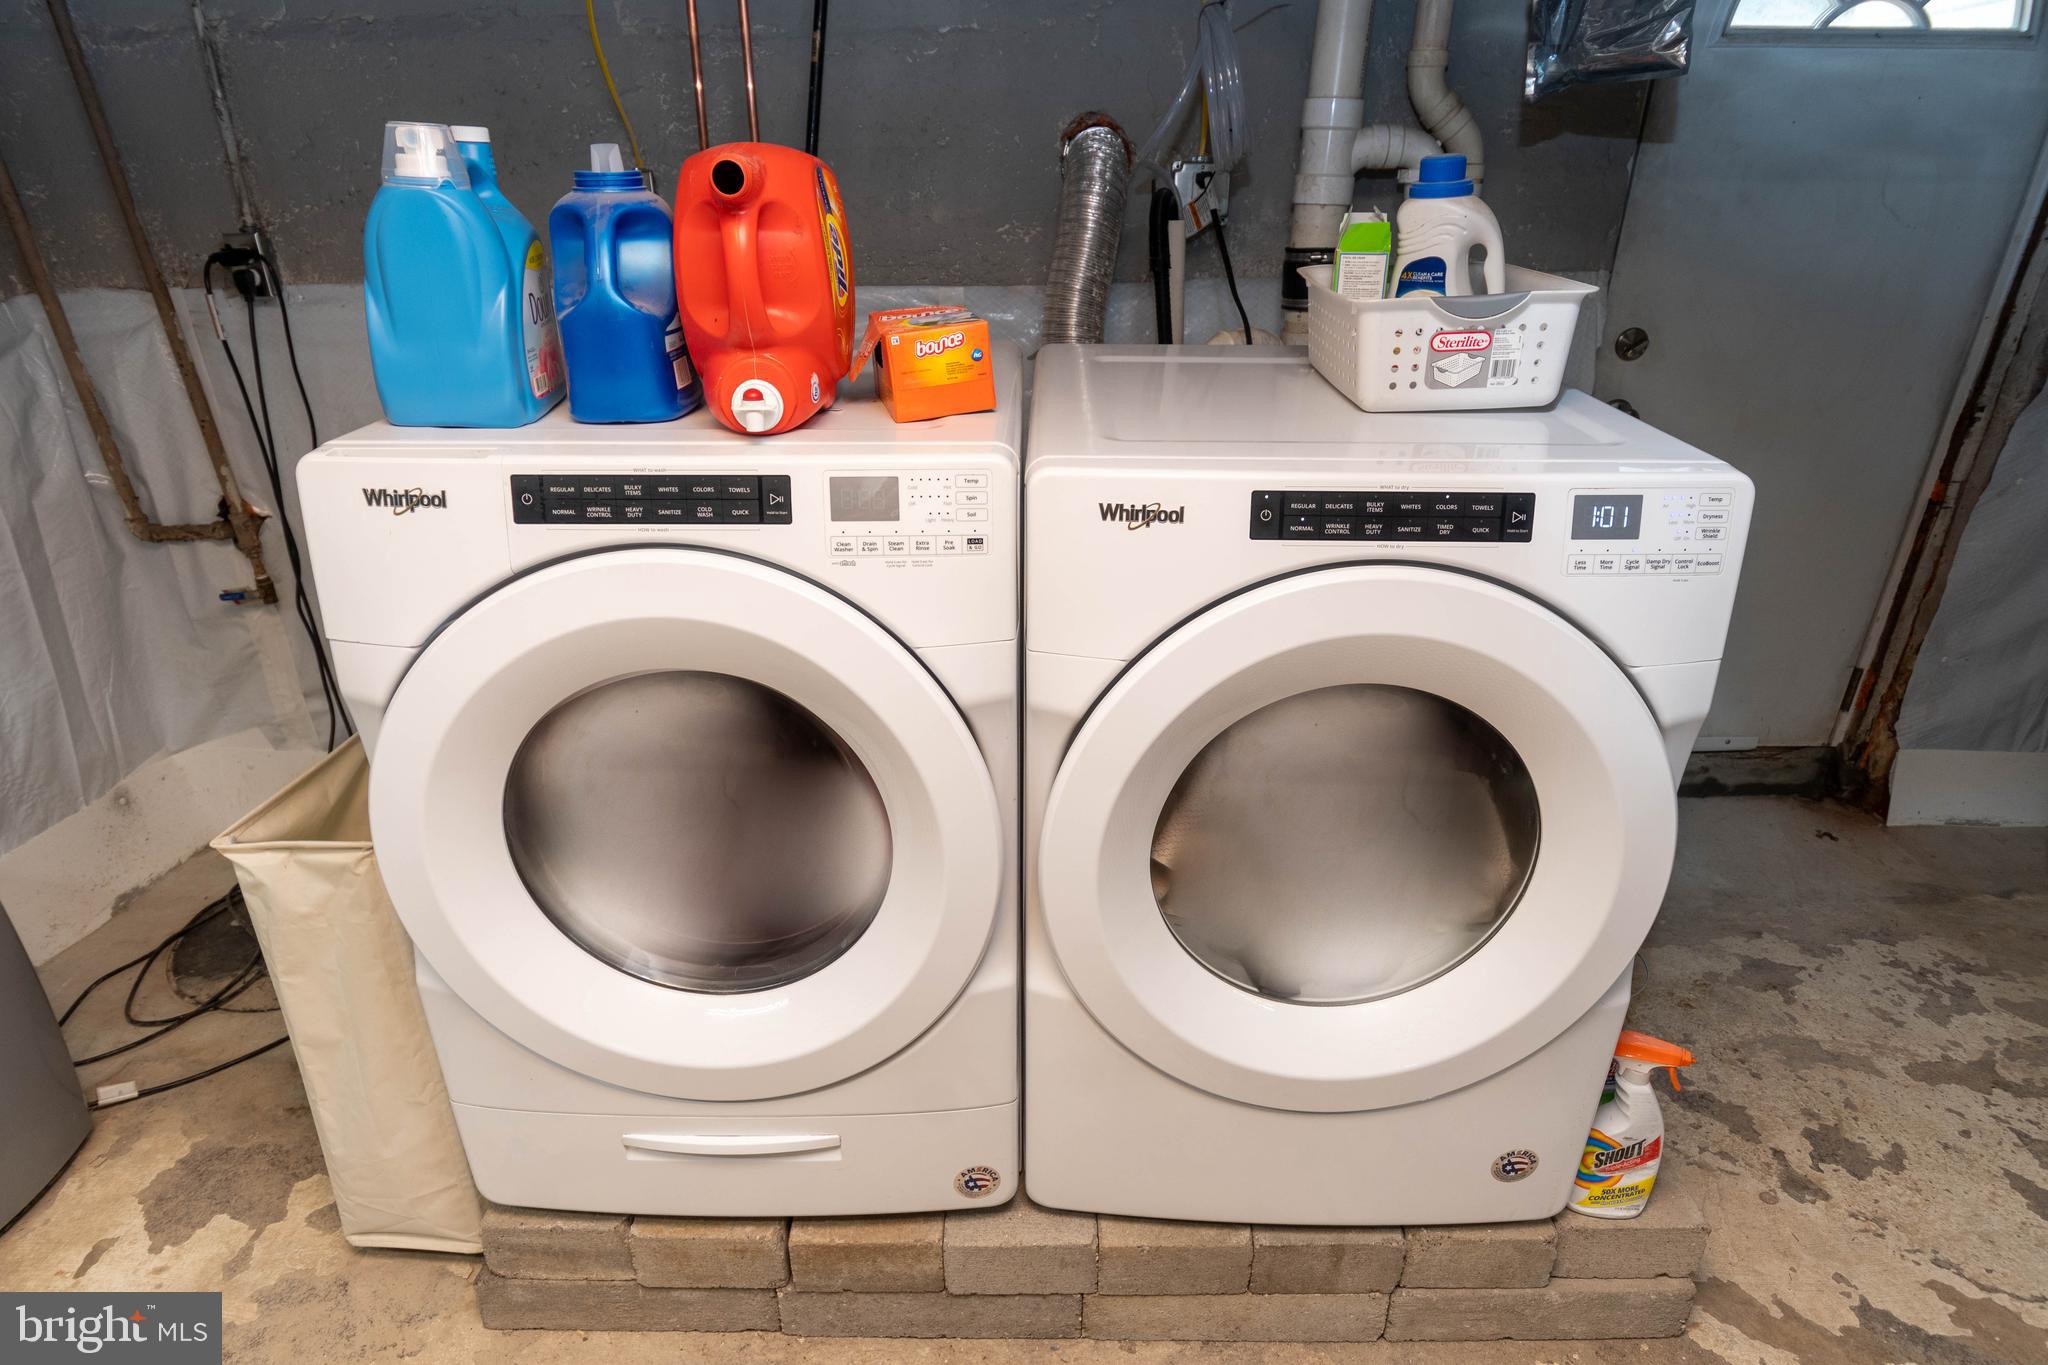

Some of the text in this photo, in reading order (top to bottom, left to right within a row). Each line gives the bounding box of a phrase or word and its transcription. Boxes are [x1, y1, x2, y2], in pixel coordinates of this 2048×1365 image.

[915, 332, 965, 358] bounce
[1437, 335, 1486, 349] Sterilite
[963, 477, 980, 487] Temp
[362, 487, 447, 515] Whirlpool
[965, 494, 978, 504] Spin
[1707, 495, 1724, 504] Temp
[657, 508, 682, 516] SANITIZE
[1325, 503, 1354, 511] DELICATES
[966, 510, 977, 519] Soil
[1098, 502, 1185, 529] Whirlpool
[1592, 505, 1629, 528] 1:01
[1702, 512, 1724, 522] Dryness
[1700, 527, 1721, 535] Wrinkle
[867, 546, 879, 554] Spin
[1574, 558, 1587, 566] Less
[1599, 558, 1614, 566] More
[1625, 558, 1640, 567] Cycle
[1646, 558, 1671, 568] Damp Dry
[1674, 558, 1694, 566] Control
[1696, 559, 1720, 567] EcoBoost
[1624, 563, 1641, 573] Signal
[1650, 563, 1666, 573] Signal
[1594, 1139, 1647, 1169] SHOUT
[961, 1166, 999, 1182] AMERICA
[1588, 1188, 1646, 1201] CONCENTRATED
[1602, 1184, 1640, 1196] 50X MORE
